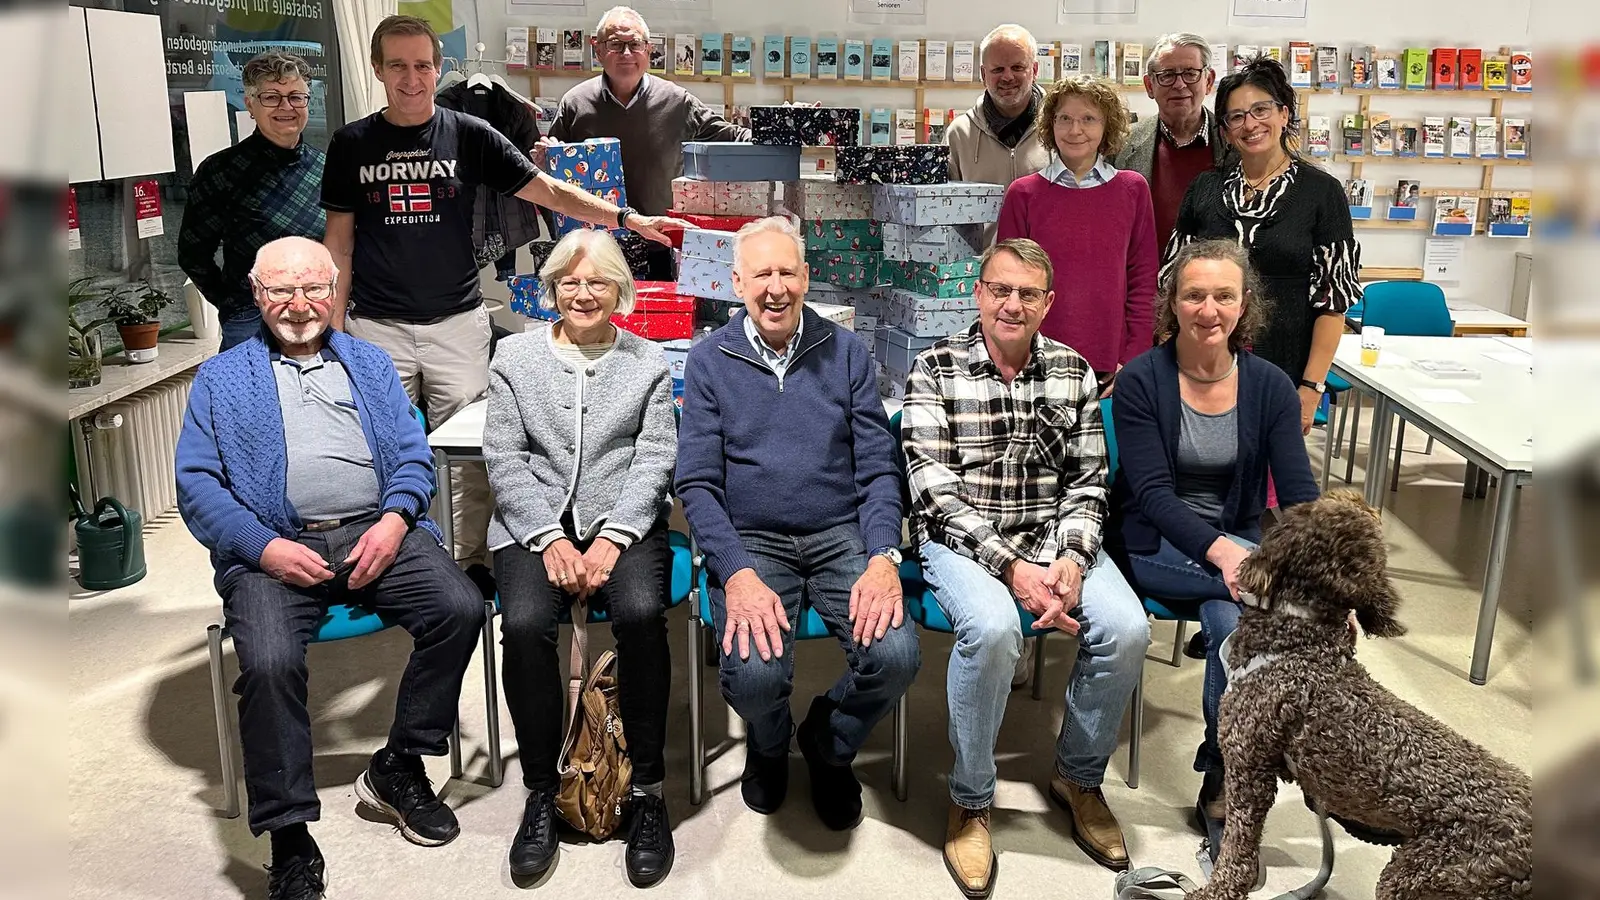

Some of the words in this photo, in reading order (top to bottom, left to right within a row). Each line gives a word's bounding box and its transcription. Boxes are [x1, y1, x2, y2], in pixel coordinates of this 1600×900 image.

[359, 159, 457, 184] NORWAY
[134, 186, 146, 198] 16.
[384, 214, 441, 225] EXPEDITION
